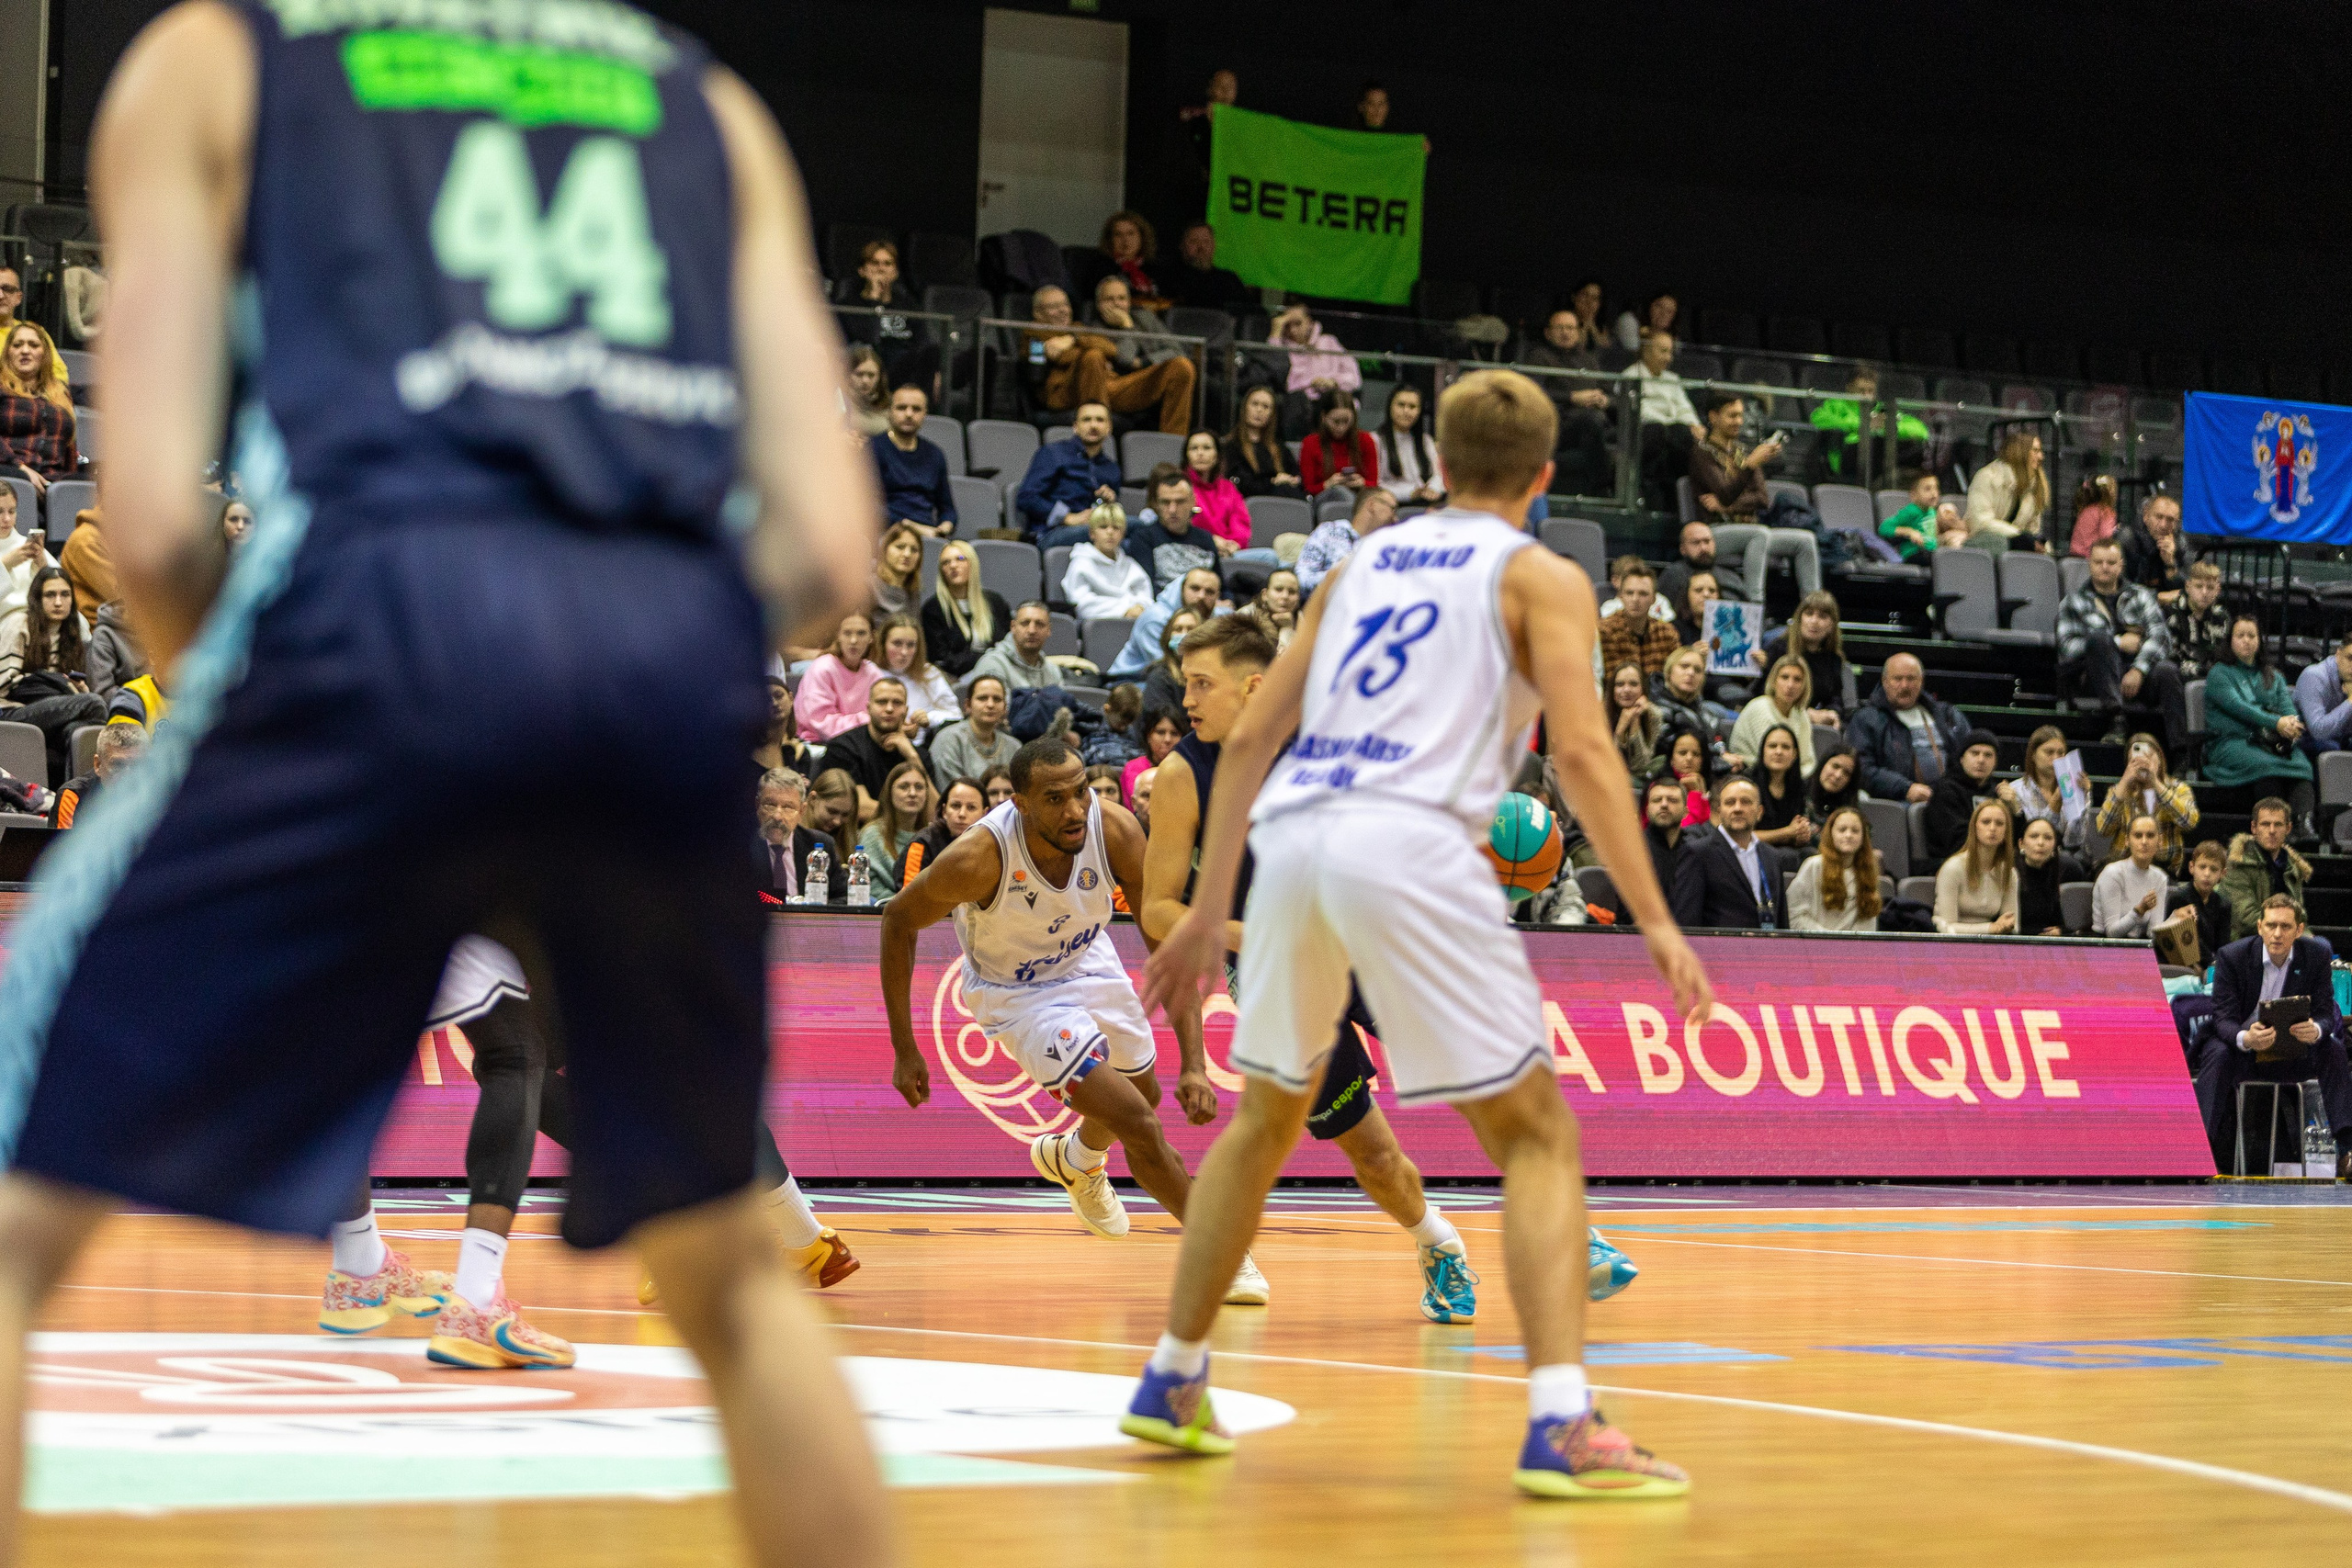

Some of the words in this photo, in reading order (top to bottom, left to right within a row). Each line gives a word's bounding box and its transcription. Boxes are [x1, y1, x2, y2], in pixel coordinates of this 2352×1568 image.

[430, 122, 673, 347] 44
[1330, 600, 1440, 698] 13
[1621, 1001, 2081, 1103] BOUTIQUE
